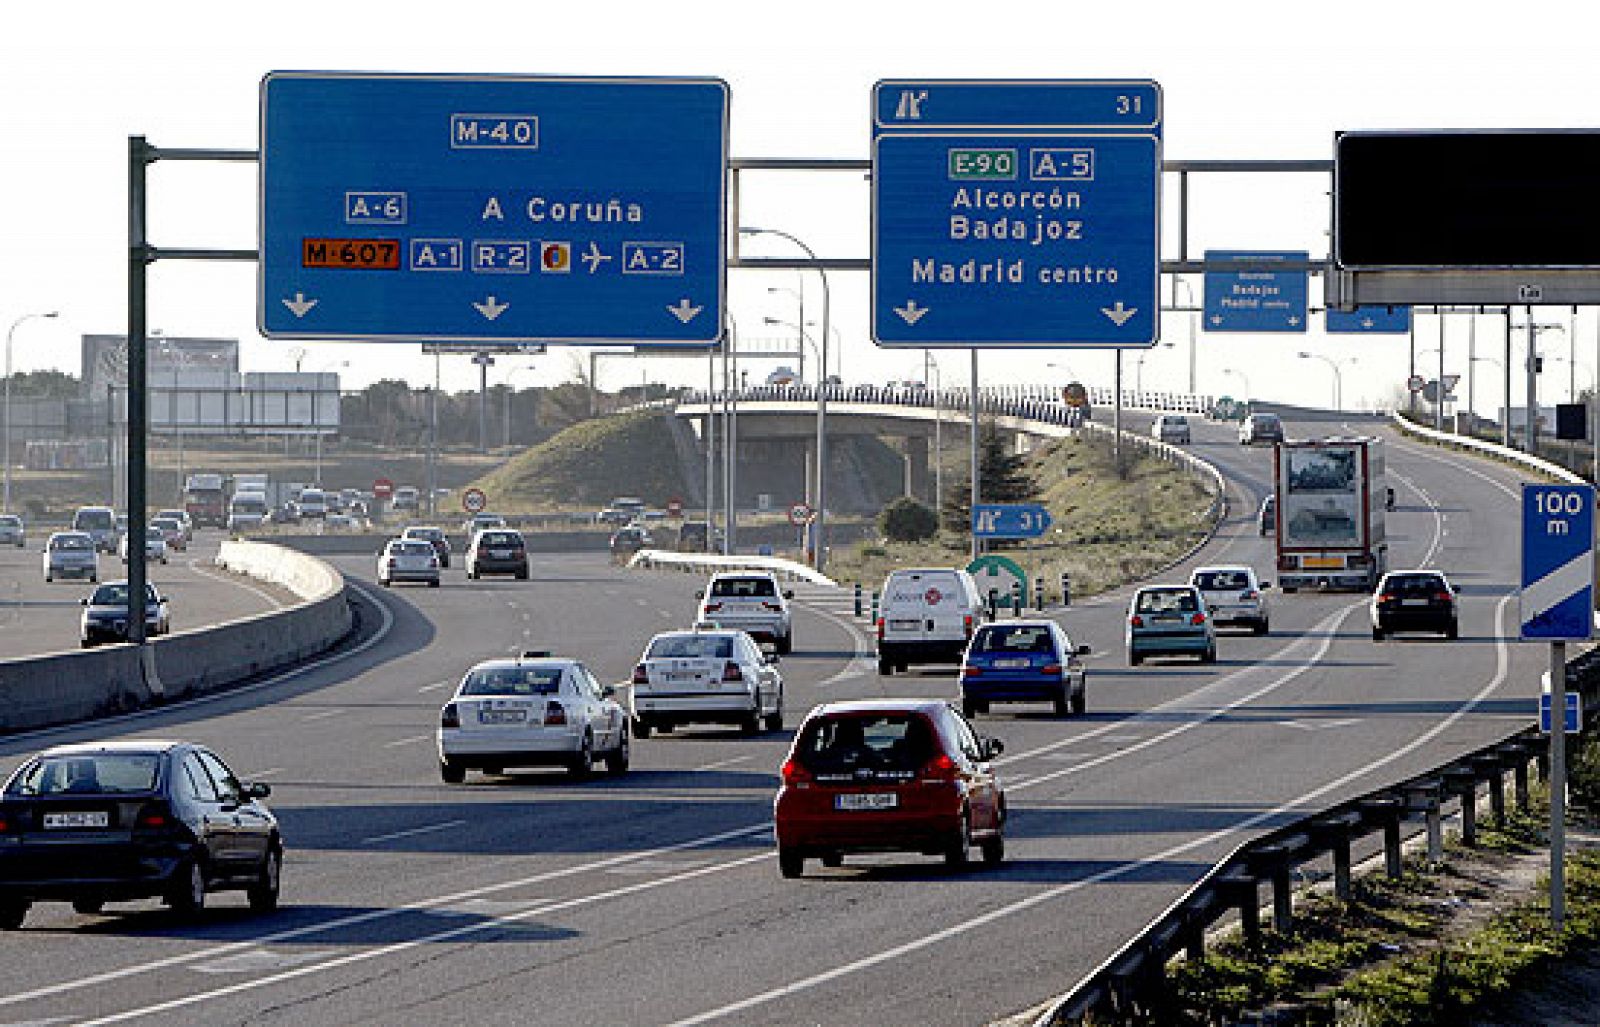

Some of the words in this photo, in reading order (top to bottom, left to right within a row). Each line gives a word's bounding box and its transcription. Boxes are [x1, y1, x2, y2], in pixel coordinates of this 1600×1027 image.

[1116, 95, 1142, 115] 31
[458, 121, 531, 143] M-40
[956, 153, 1011, 173] E-90
[1035, 153, 1089, 175] A-5
[952, 187, 1080, 209] Alcorcón
[351, 198, 400, 217] A-6
[482, 197, 504, 219] A
[528, 197, 641, 222] Coruña
[950, 214, 1083, 246] Badajoz
[307, 244, 395, 265] M-607
[416, 245, 458, 266] A-1
[477, 245, 526, 267] R-2
[628, 248, 680, 268] A-2
[912, 258, 1024, 283] Madrid
[1039, 265, 1118, 283] centro
[1535, 491, 1583, 515] 100
[1020, 511, 1043, 530] 31
[1547, 519, 1569, 534] m
